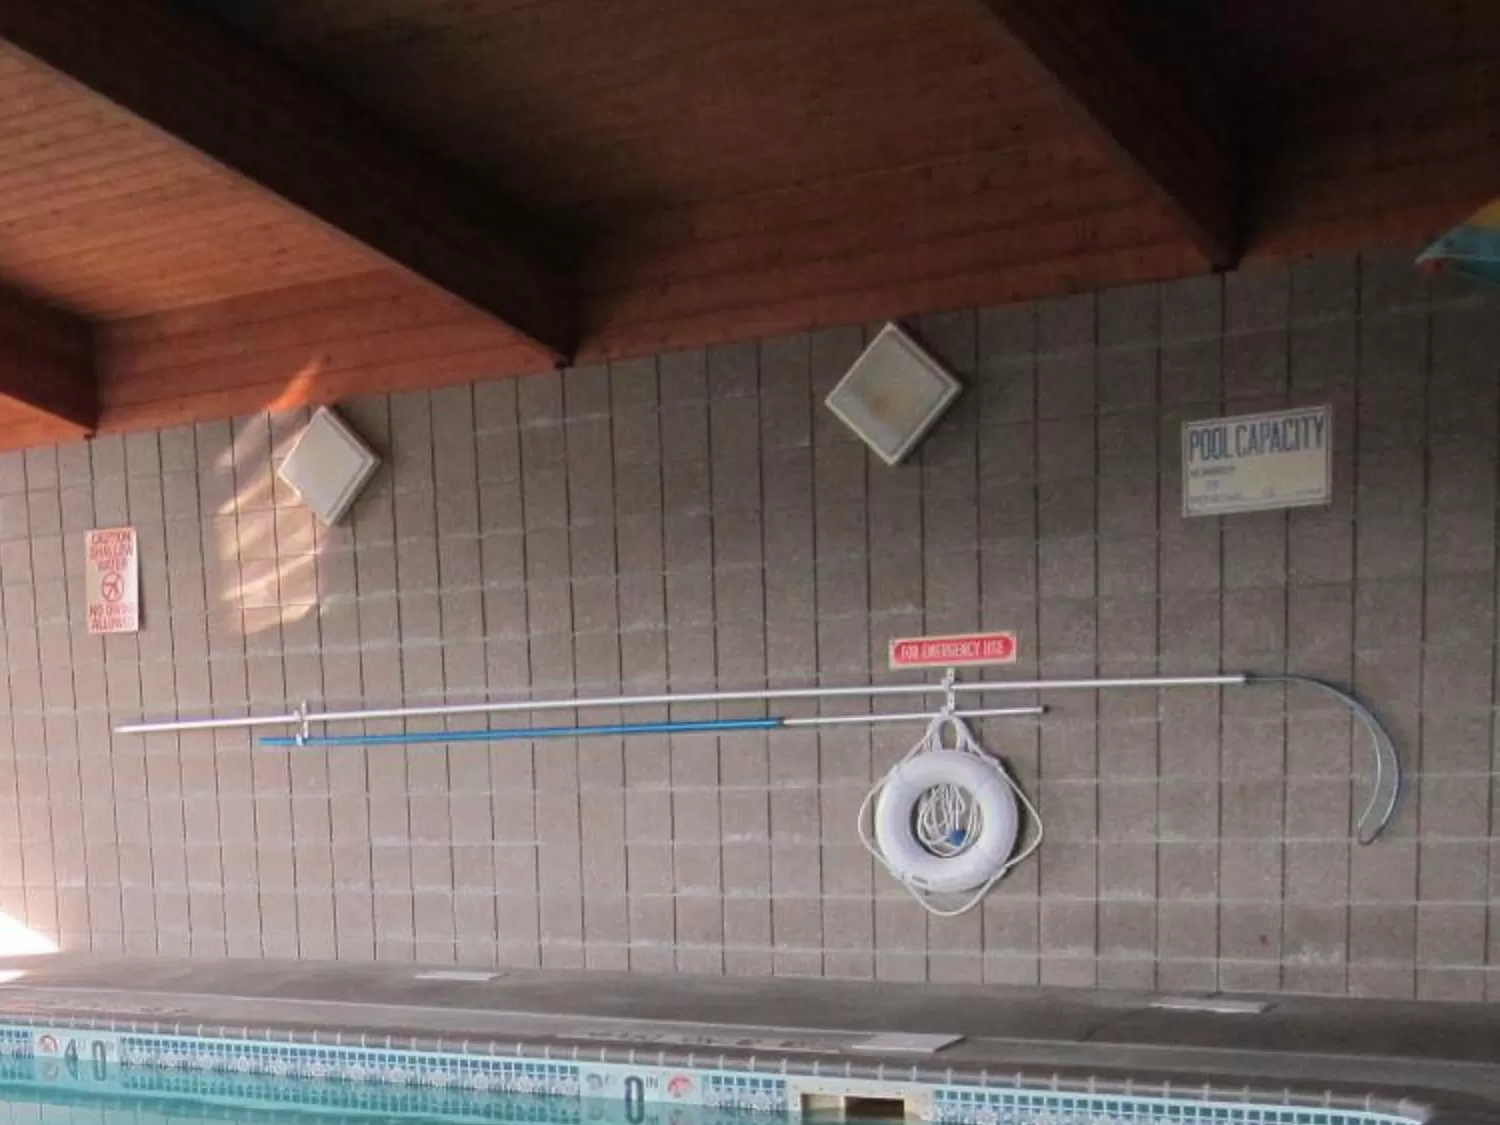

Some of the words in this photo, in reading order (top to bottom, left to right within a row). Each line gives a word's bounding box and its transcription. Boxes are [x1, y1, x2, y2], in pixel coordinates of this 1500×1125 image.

[1189, 426, 1234, 463] POOL
[1235, 416, 1324, 457] CAPACITY
[983, 639, 1005, 655] USE
